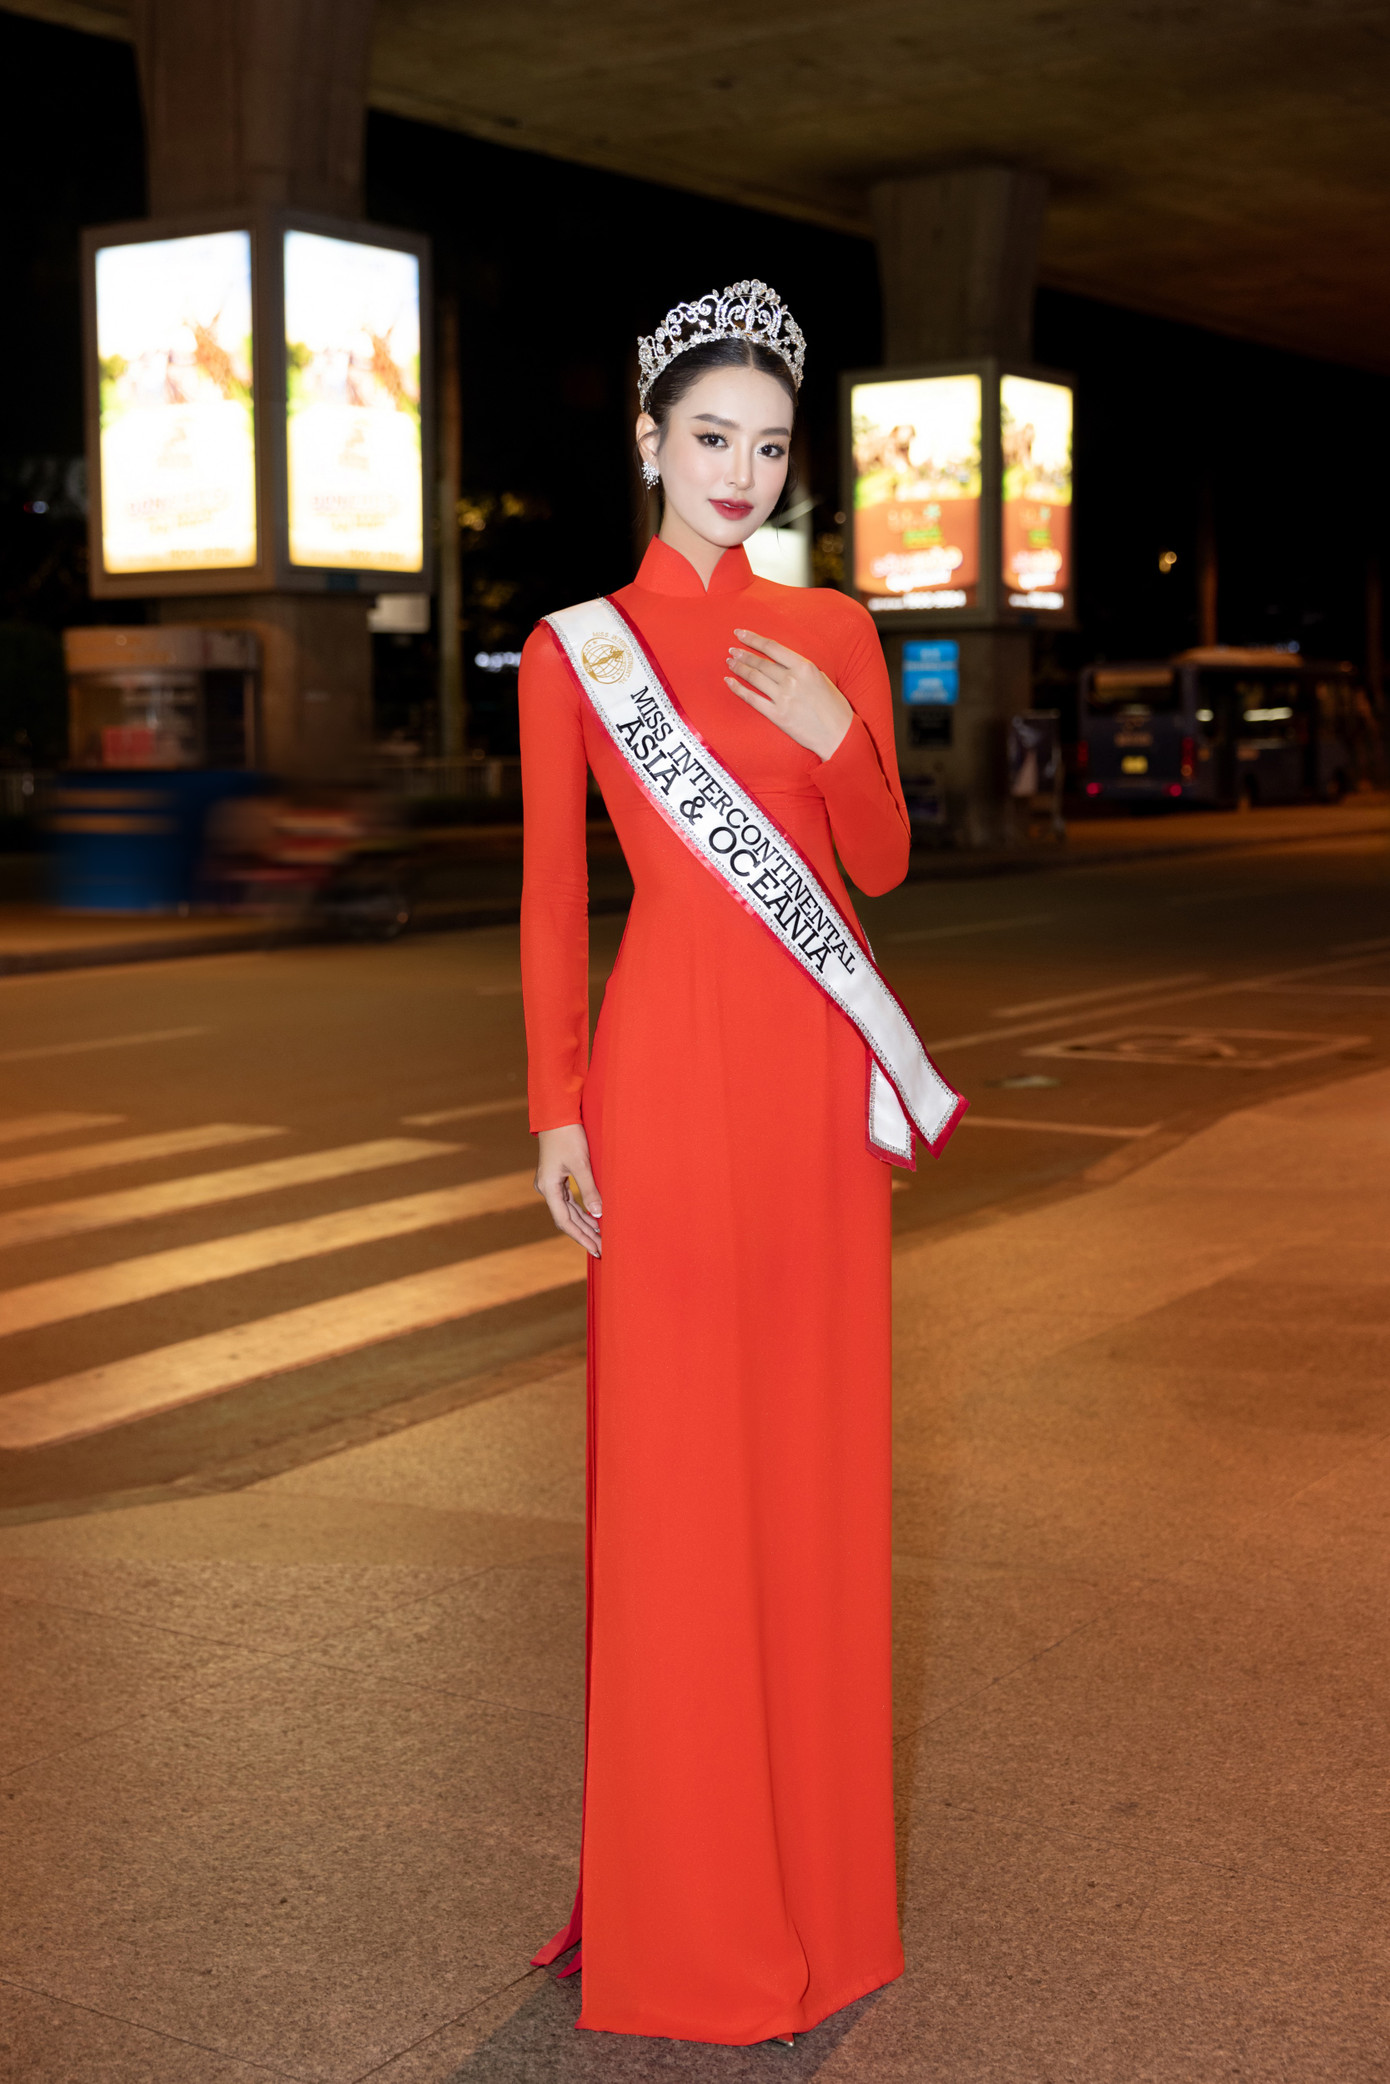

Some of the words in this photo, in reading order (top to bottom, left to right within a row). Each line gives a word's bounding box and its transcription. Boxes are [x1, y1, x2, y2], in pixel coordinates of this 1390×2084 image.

[615, 715, 682, 796] ASIA
[679, 795, 707, 827] &
[708, 826, 832, 974] OCEANIA
[630, 685, 674, 742] MISS
[666, 741, 856, 975] INTERCONTINENTAL
